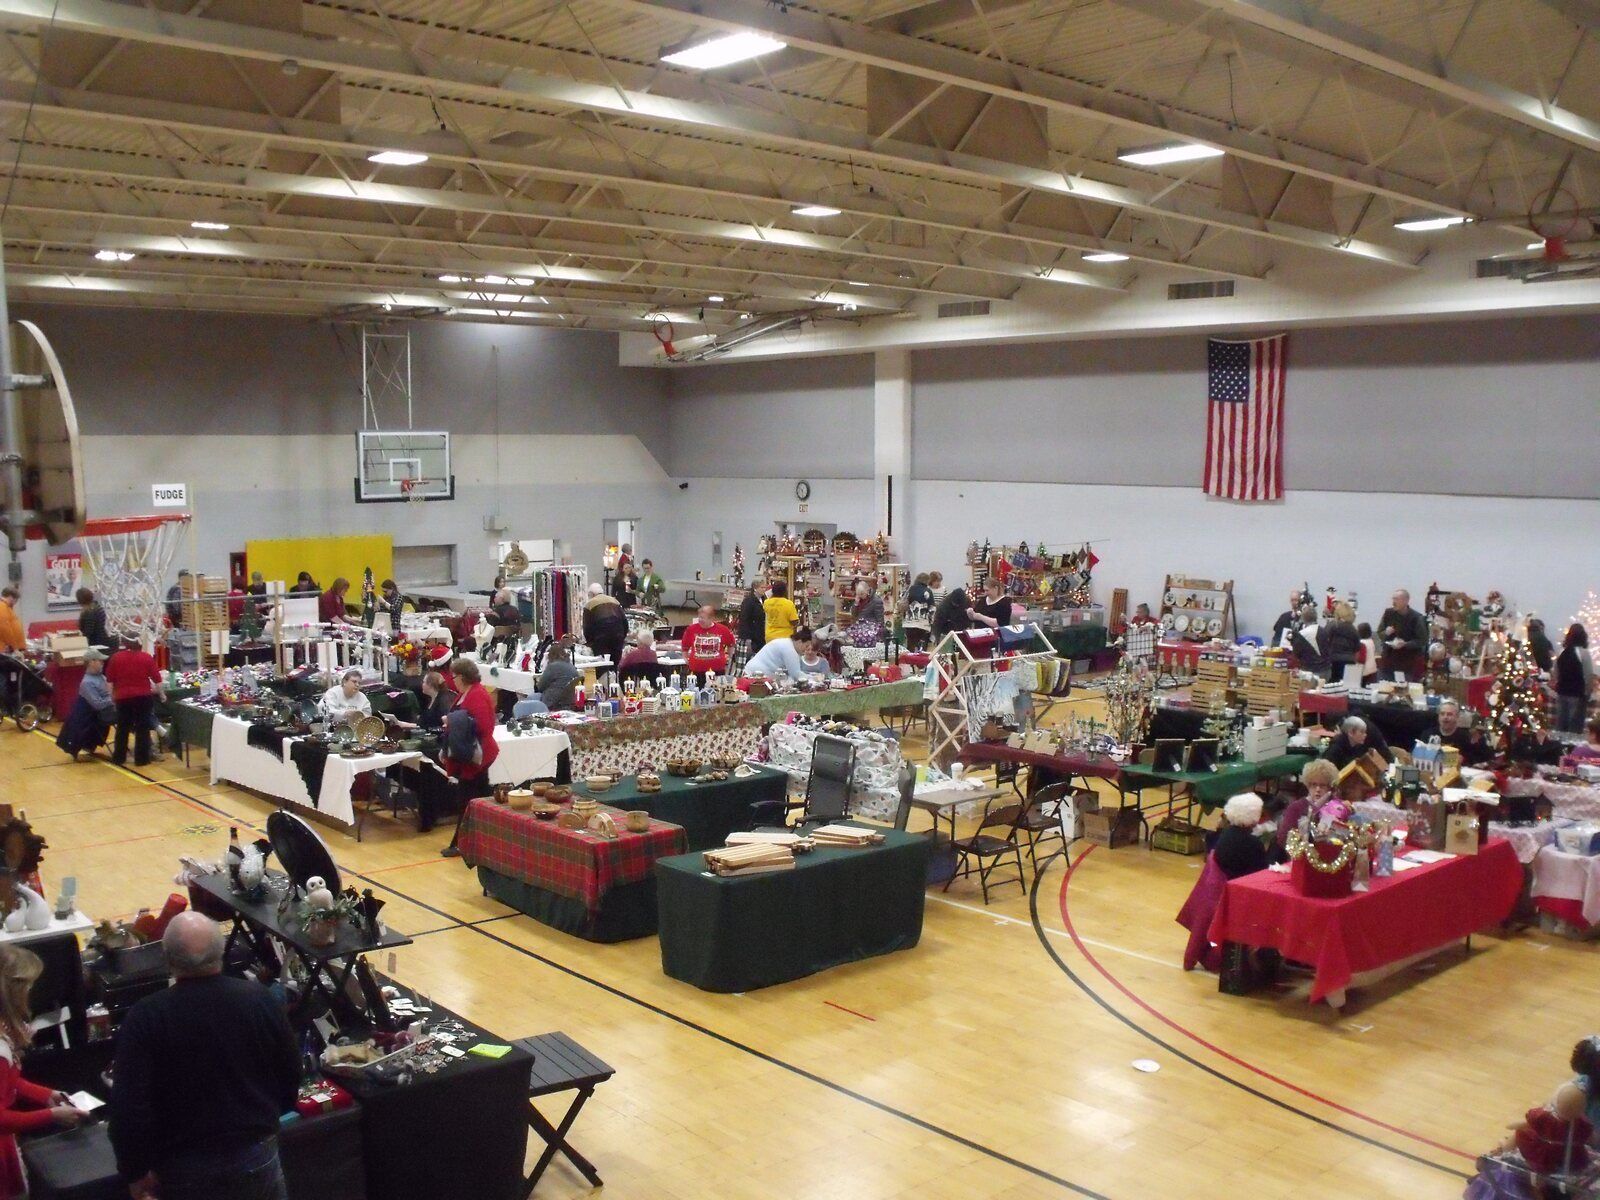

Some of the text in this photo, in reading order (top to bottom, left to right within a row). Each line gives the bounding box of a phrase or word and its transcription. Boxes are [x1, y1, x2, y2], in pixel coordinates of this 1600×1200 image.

[155, 489, 184, 500] FUDGE
[799, 504, 808, 512] EXIT
[51, 558, 80, 569] GOT IT
